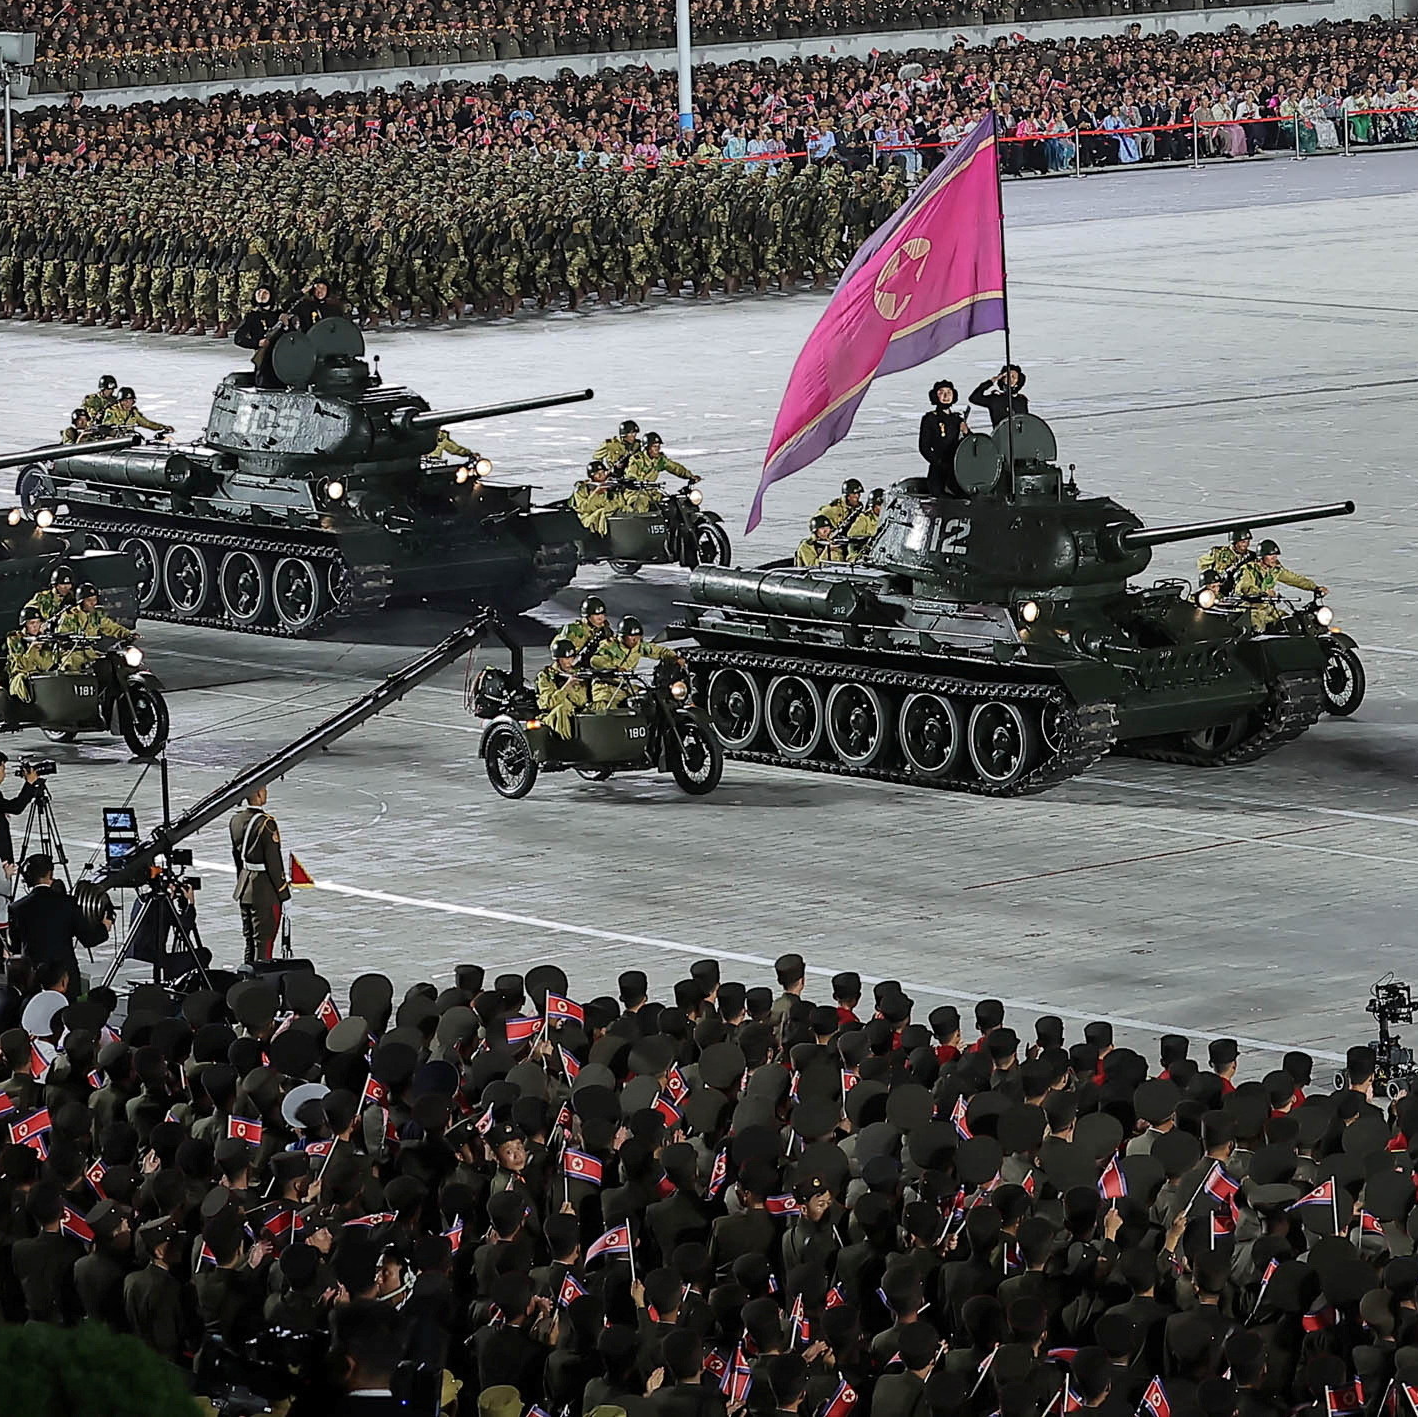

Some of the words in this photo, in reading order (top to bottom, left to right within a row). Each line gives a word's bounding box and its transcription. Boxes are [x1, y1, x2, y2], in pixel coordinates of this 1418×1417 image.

[650, 524, 665, 534] 155
[79, 685, 93, 696] 181
[629, 726, 646, 739] 180
